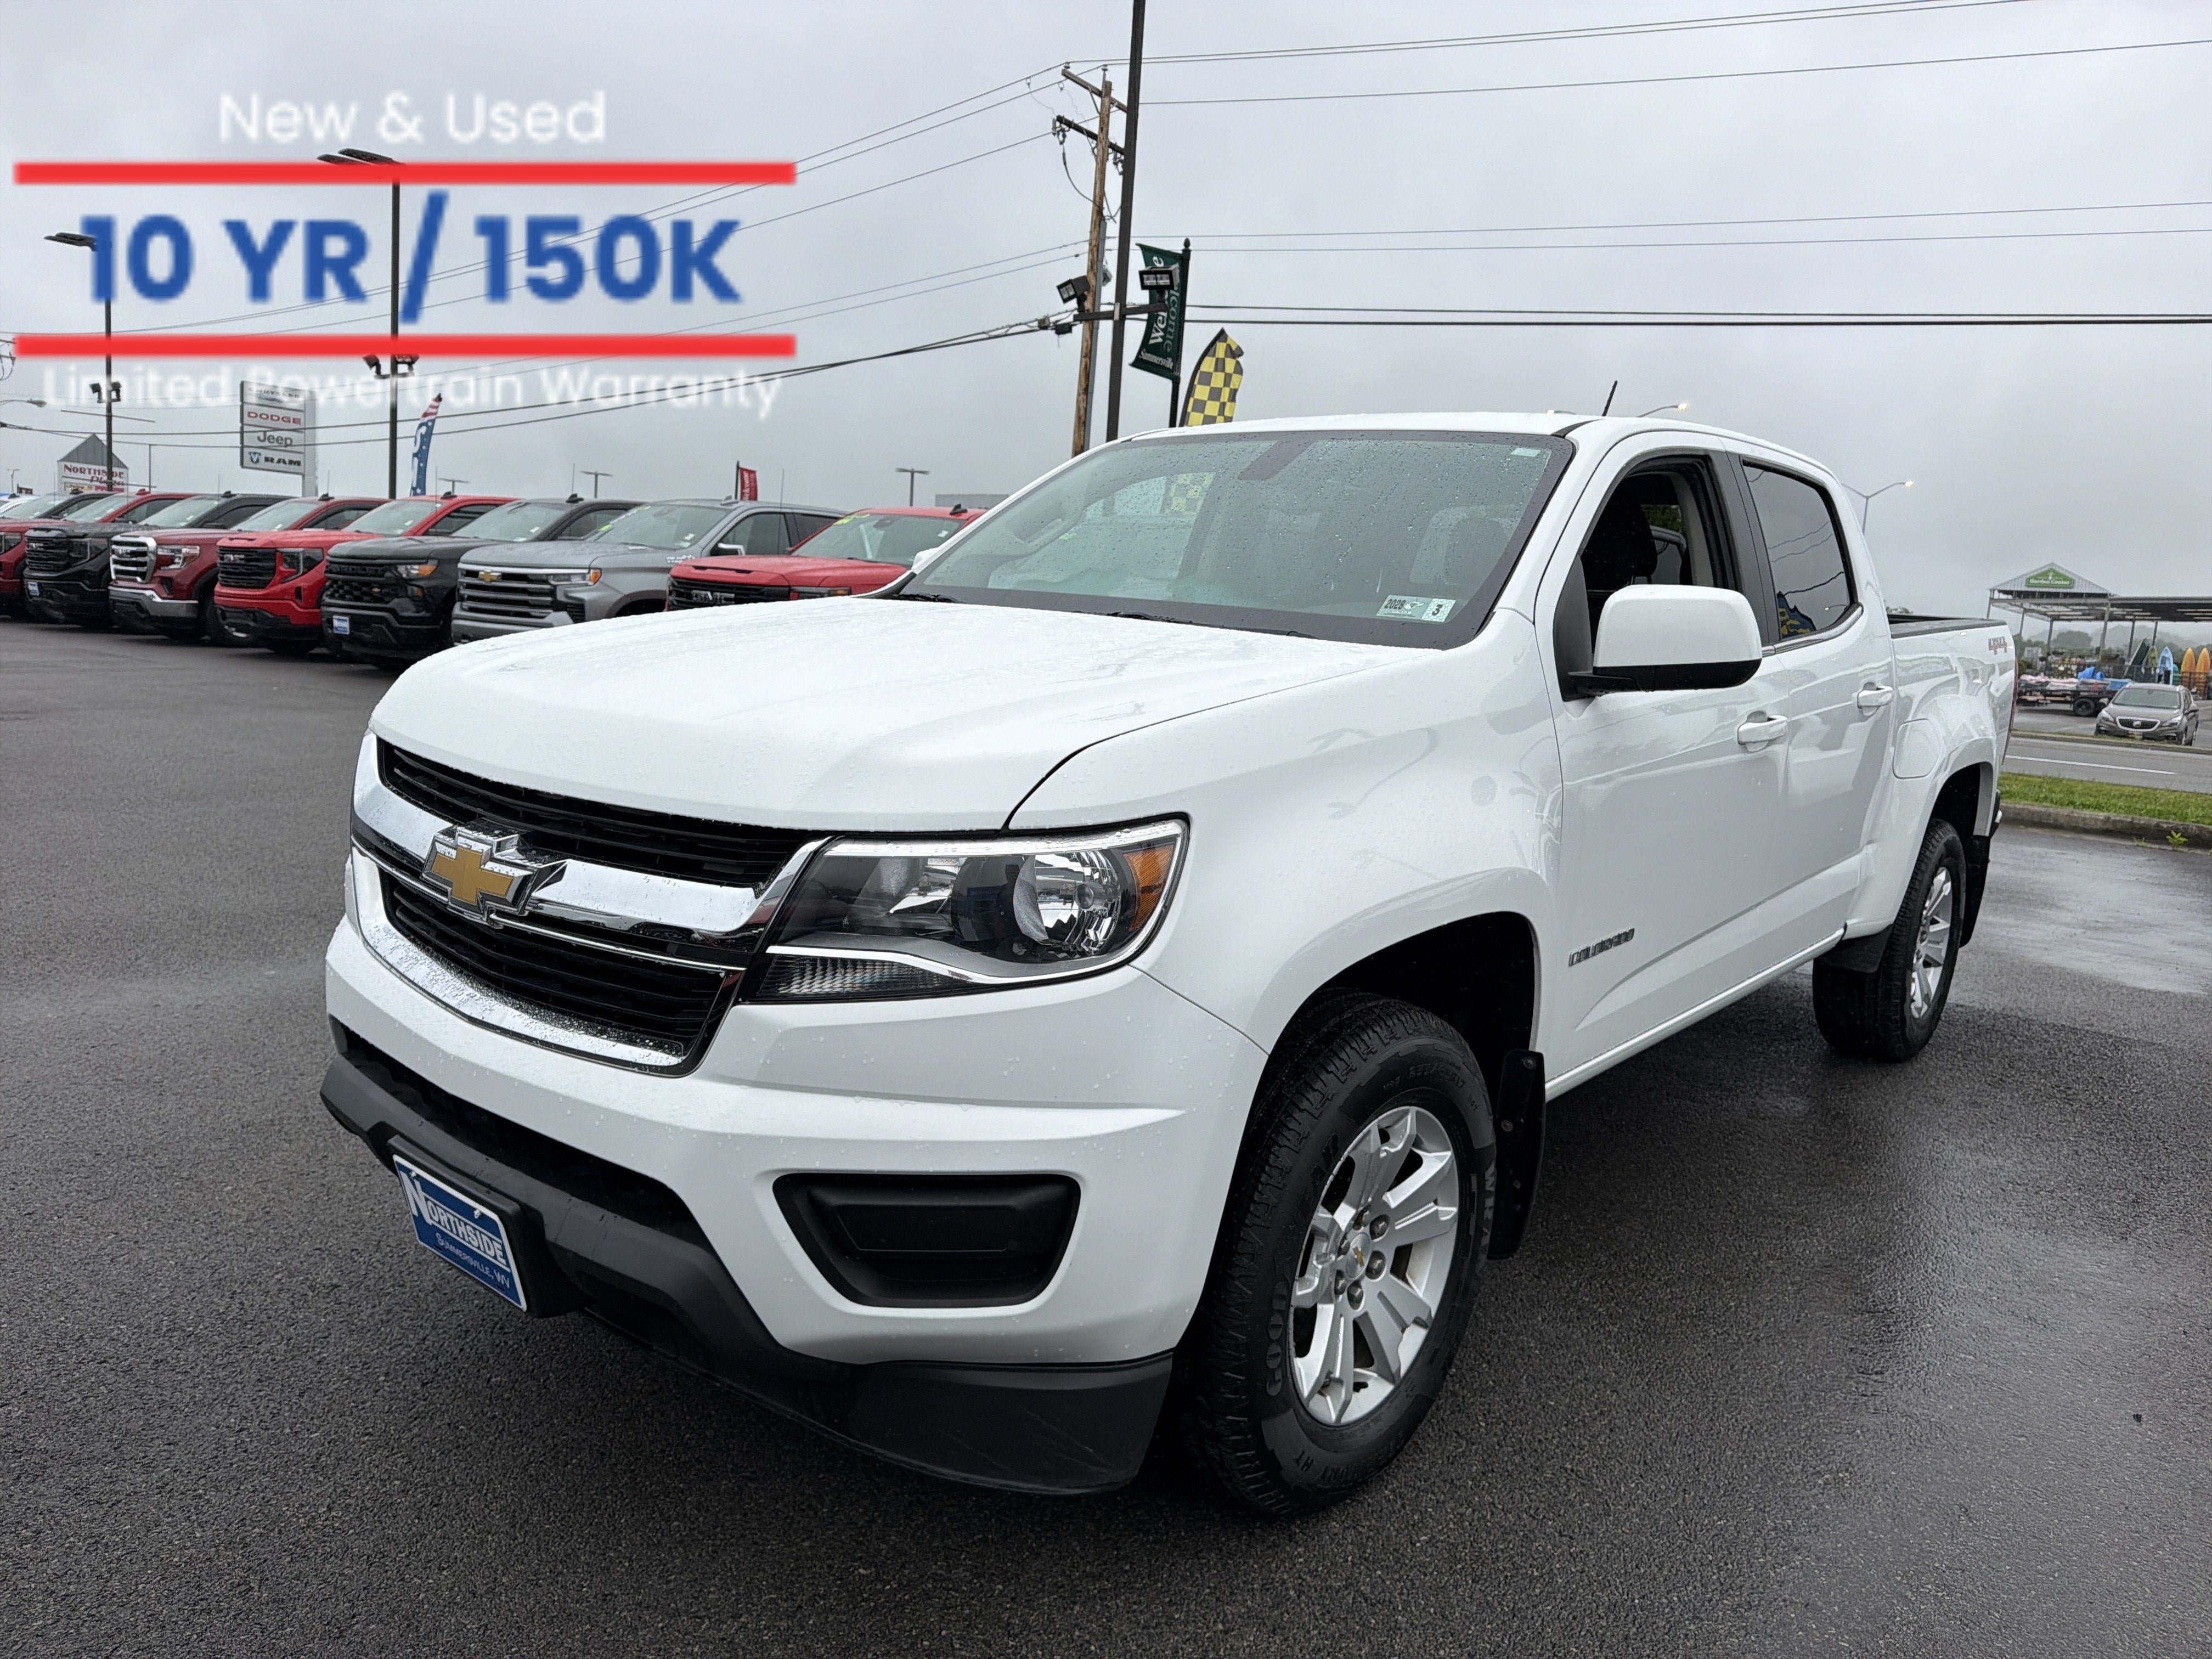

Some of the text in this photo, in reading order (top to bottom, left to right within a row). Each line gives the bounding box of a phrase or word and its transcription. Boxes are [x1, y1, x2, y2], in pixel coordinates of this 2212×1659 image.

[247, 411, 301, 425] DODGE
[257, 431, 293, 448] Jeep
[264, 456, 301, 466] RAM
[691, 590, 735, 604] GMC
[1383, 599, 1443, 616] 2028 3
[400, 1170, 506, 1266] NORTHSIDE
[494, 1272, 510, 1288] WV
